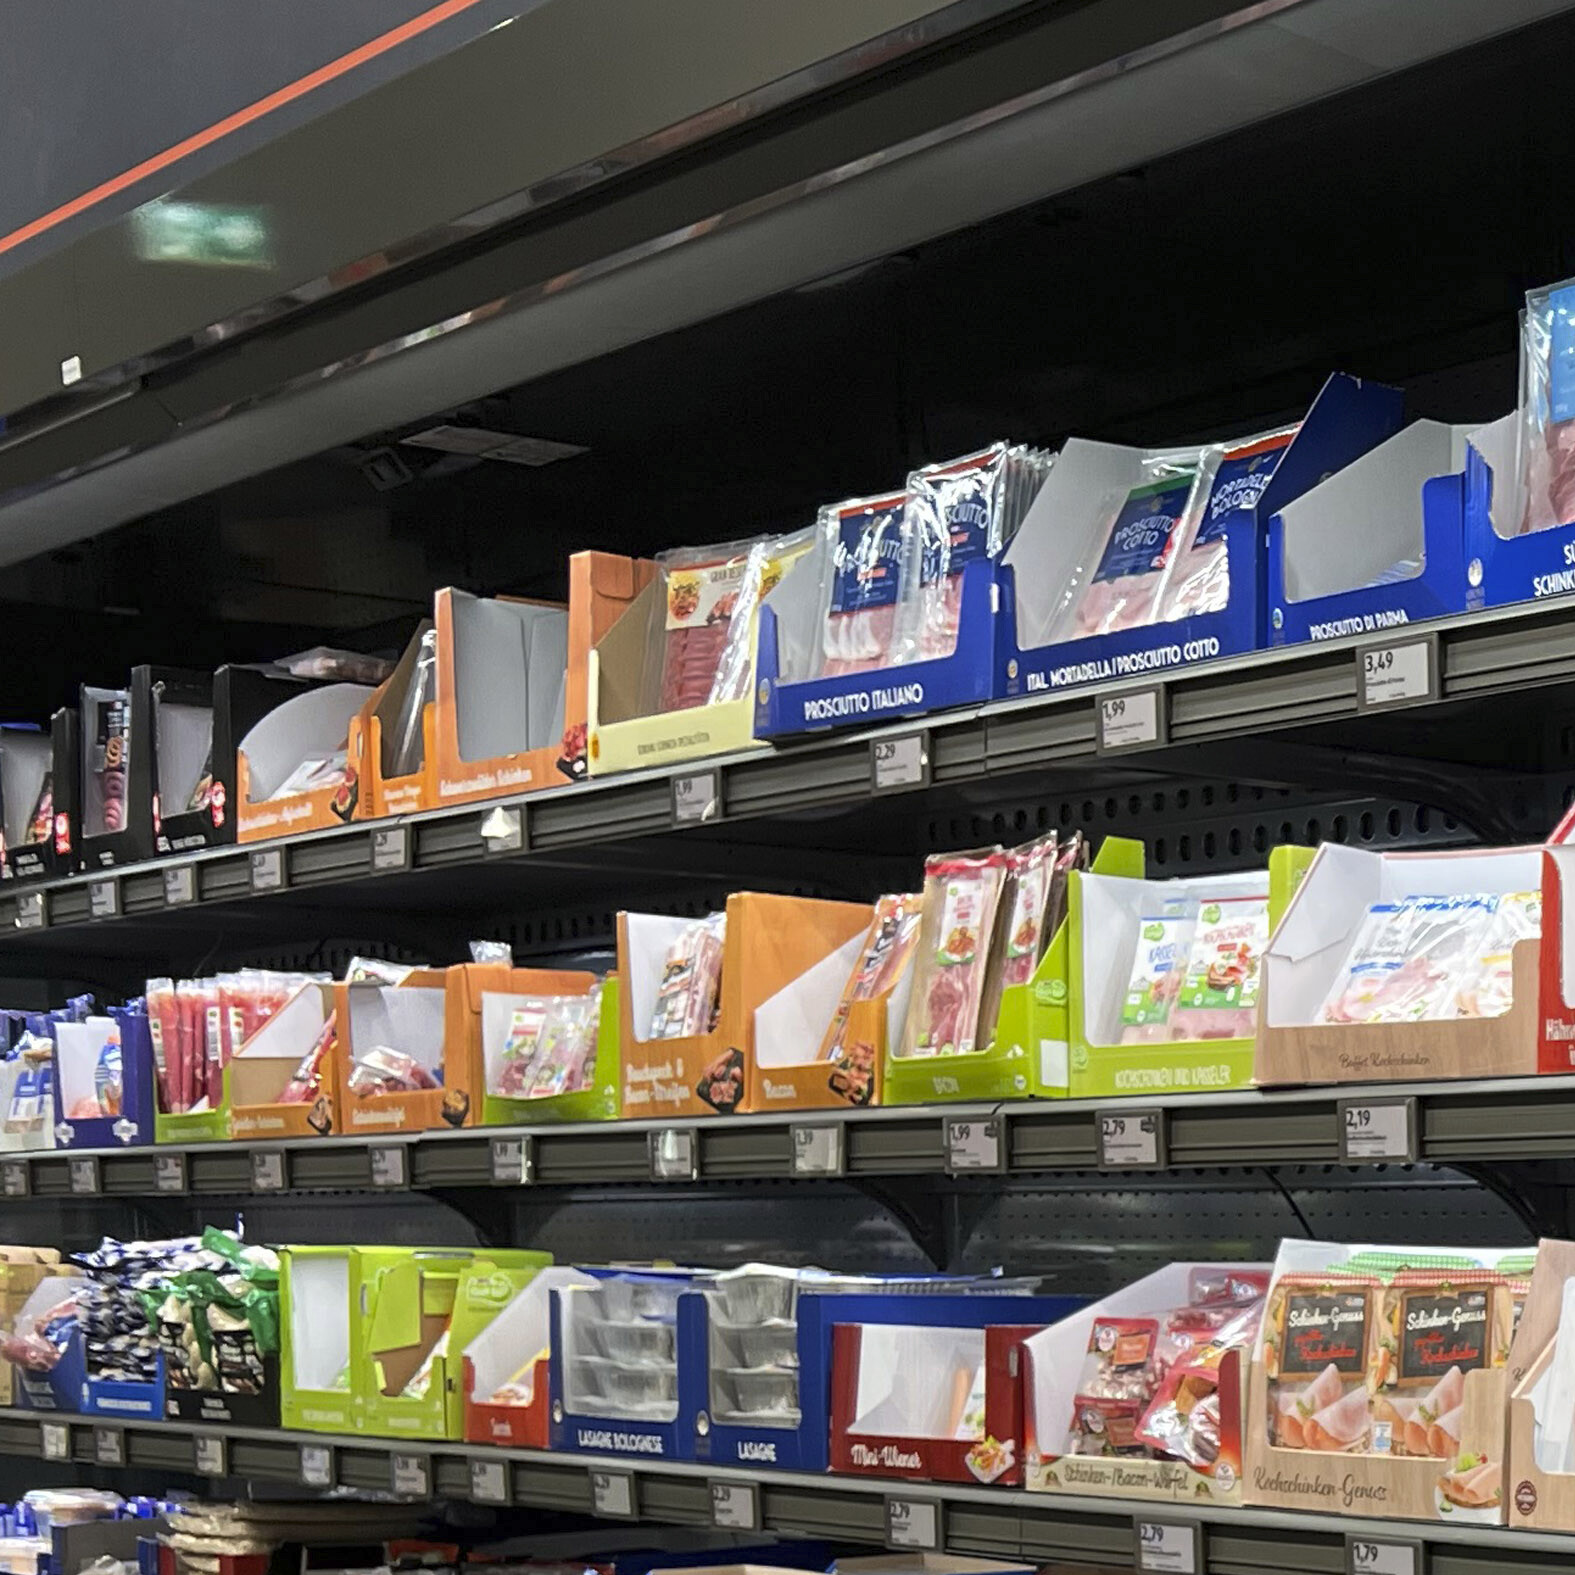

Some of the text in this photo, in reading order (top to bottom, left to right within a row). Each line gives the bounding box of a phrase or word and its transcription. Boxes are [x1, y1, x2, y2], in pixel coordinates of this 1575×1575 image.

[1309, 608, 1409, 640] PROSCIUTTO DI PARMA
[1050, 663, 1111, 688] MORTADELLA
[1117, 646, 1182, 675] PROSCIUTTO
[1184, 636, 1220, 661] COTTO
[1365, 651, 1394, 675] 3,49
[804, 682, 924, 721] PROSCIUTTO ITALIANO
[1346, 1109, 1370, 1131] 2,19
[1288, 1306, 1364, 1332] Schinken-Genuss
[1406, 1306, 1487, 1332] Schinken-Genuss
[1253, 1467, 1388, 1506] Kochschinken-Genuss
[1141, 1524, 1164, 1543] 2,79
[1352, 1543, 1379, 1563] 1,79
